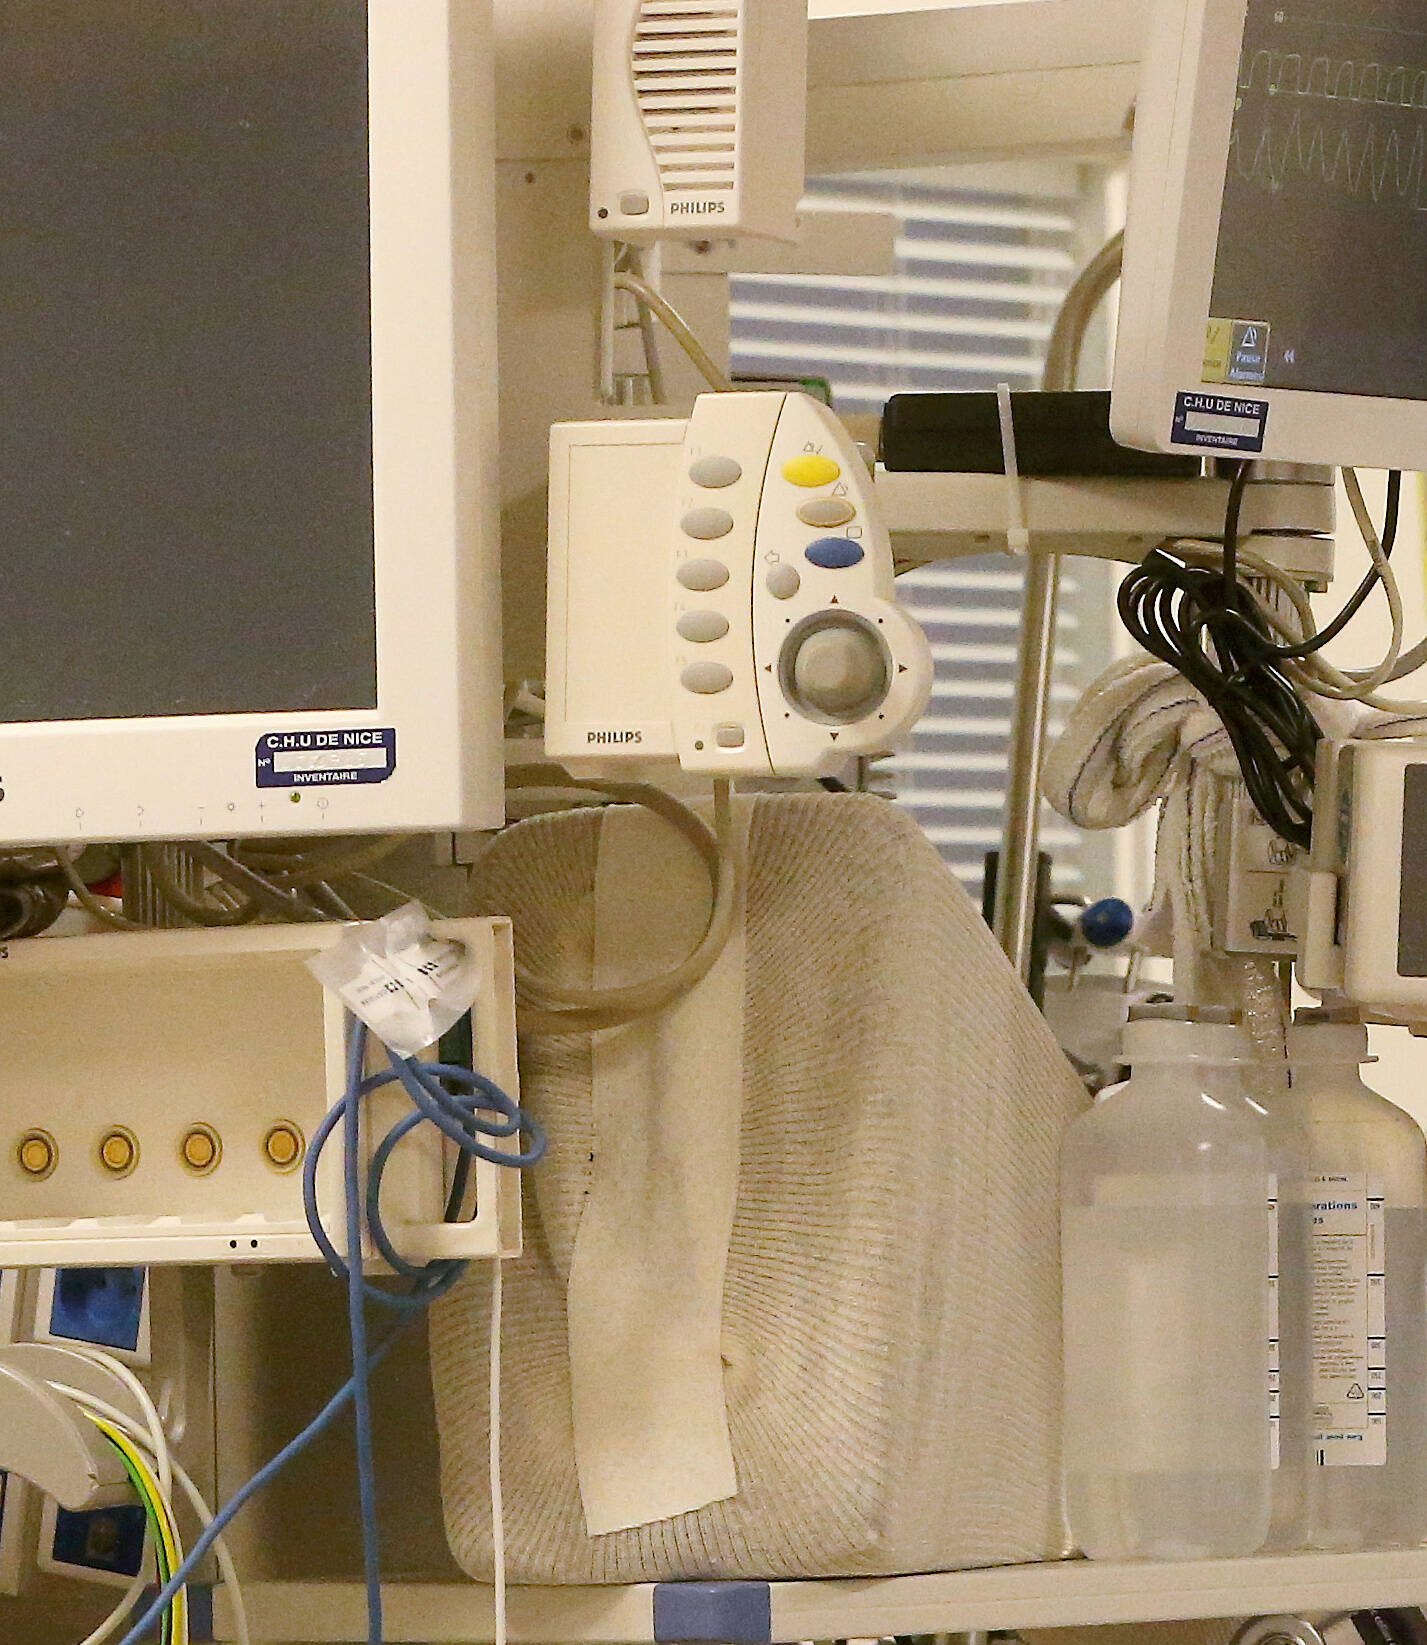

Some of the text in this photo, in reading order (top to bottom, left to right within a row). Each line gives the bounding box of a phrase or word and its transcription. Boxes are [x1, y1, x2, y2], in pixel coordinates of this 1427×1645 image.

[669, 201, 725, 215] PHILIPS
[1216, 399, 1232, 412] DE
[1234, 401, 1261, 416] NICE
[266, 731, 383, 749] C.H.U DE NICE
[586, 731, 643, 744] PHILIPS
[293, 771, 358, 782] INVENTAIRE
